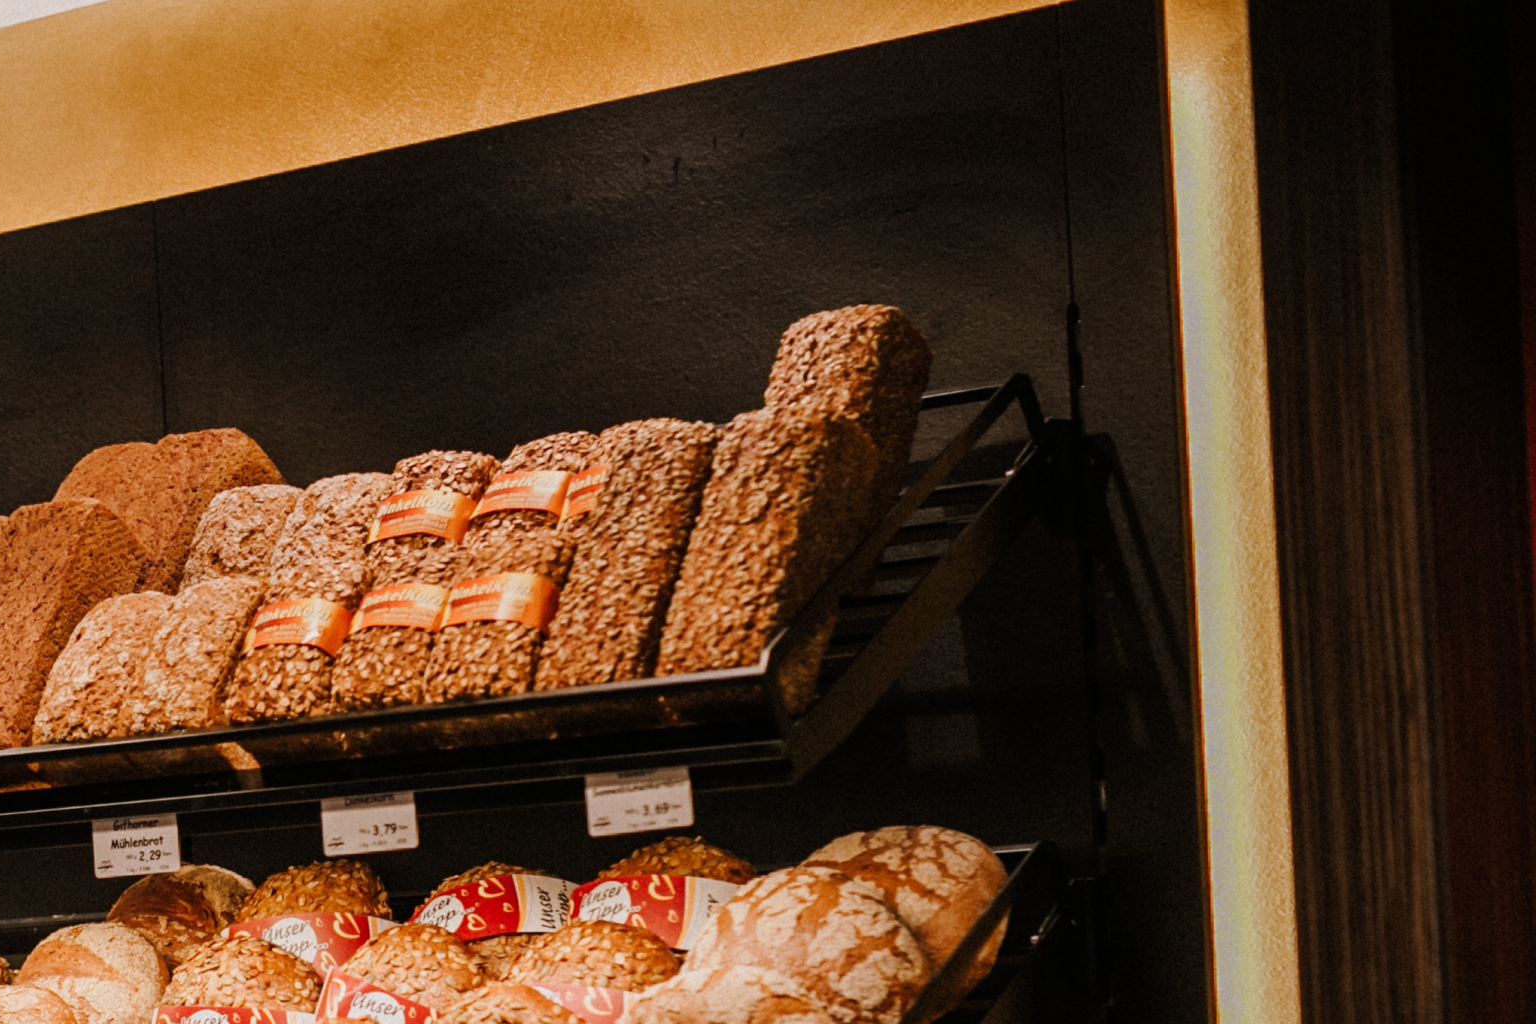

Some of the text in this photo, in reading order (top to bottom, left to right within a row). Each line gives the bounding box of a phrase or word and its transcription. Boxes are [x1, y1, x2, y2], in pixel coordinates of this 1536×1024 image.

[111, 836, 164, 850] Mühlenbrot
[139, 850, 161, 863] 2,29
[537, 886, 558, 930] Unser
[262, 920, 311, 943] Unser
[352, 992, 405, 1017] Unser
